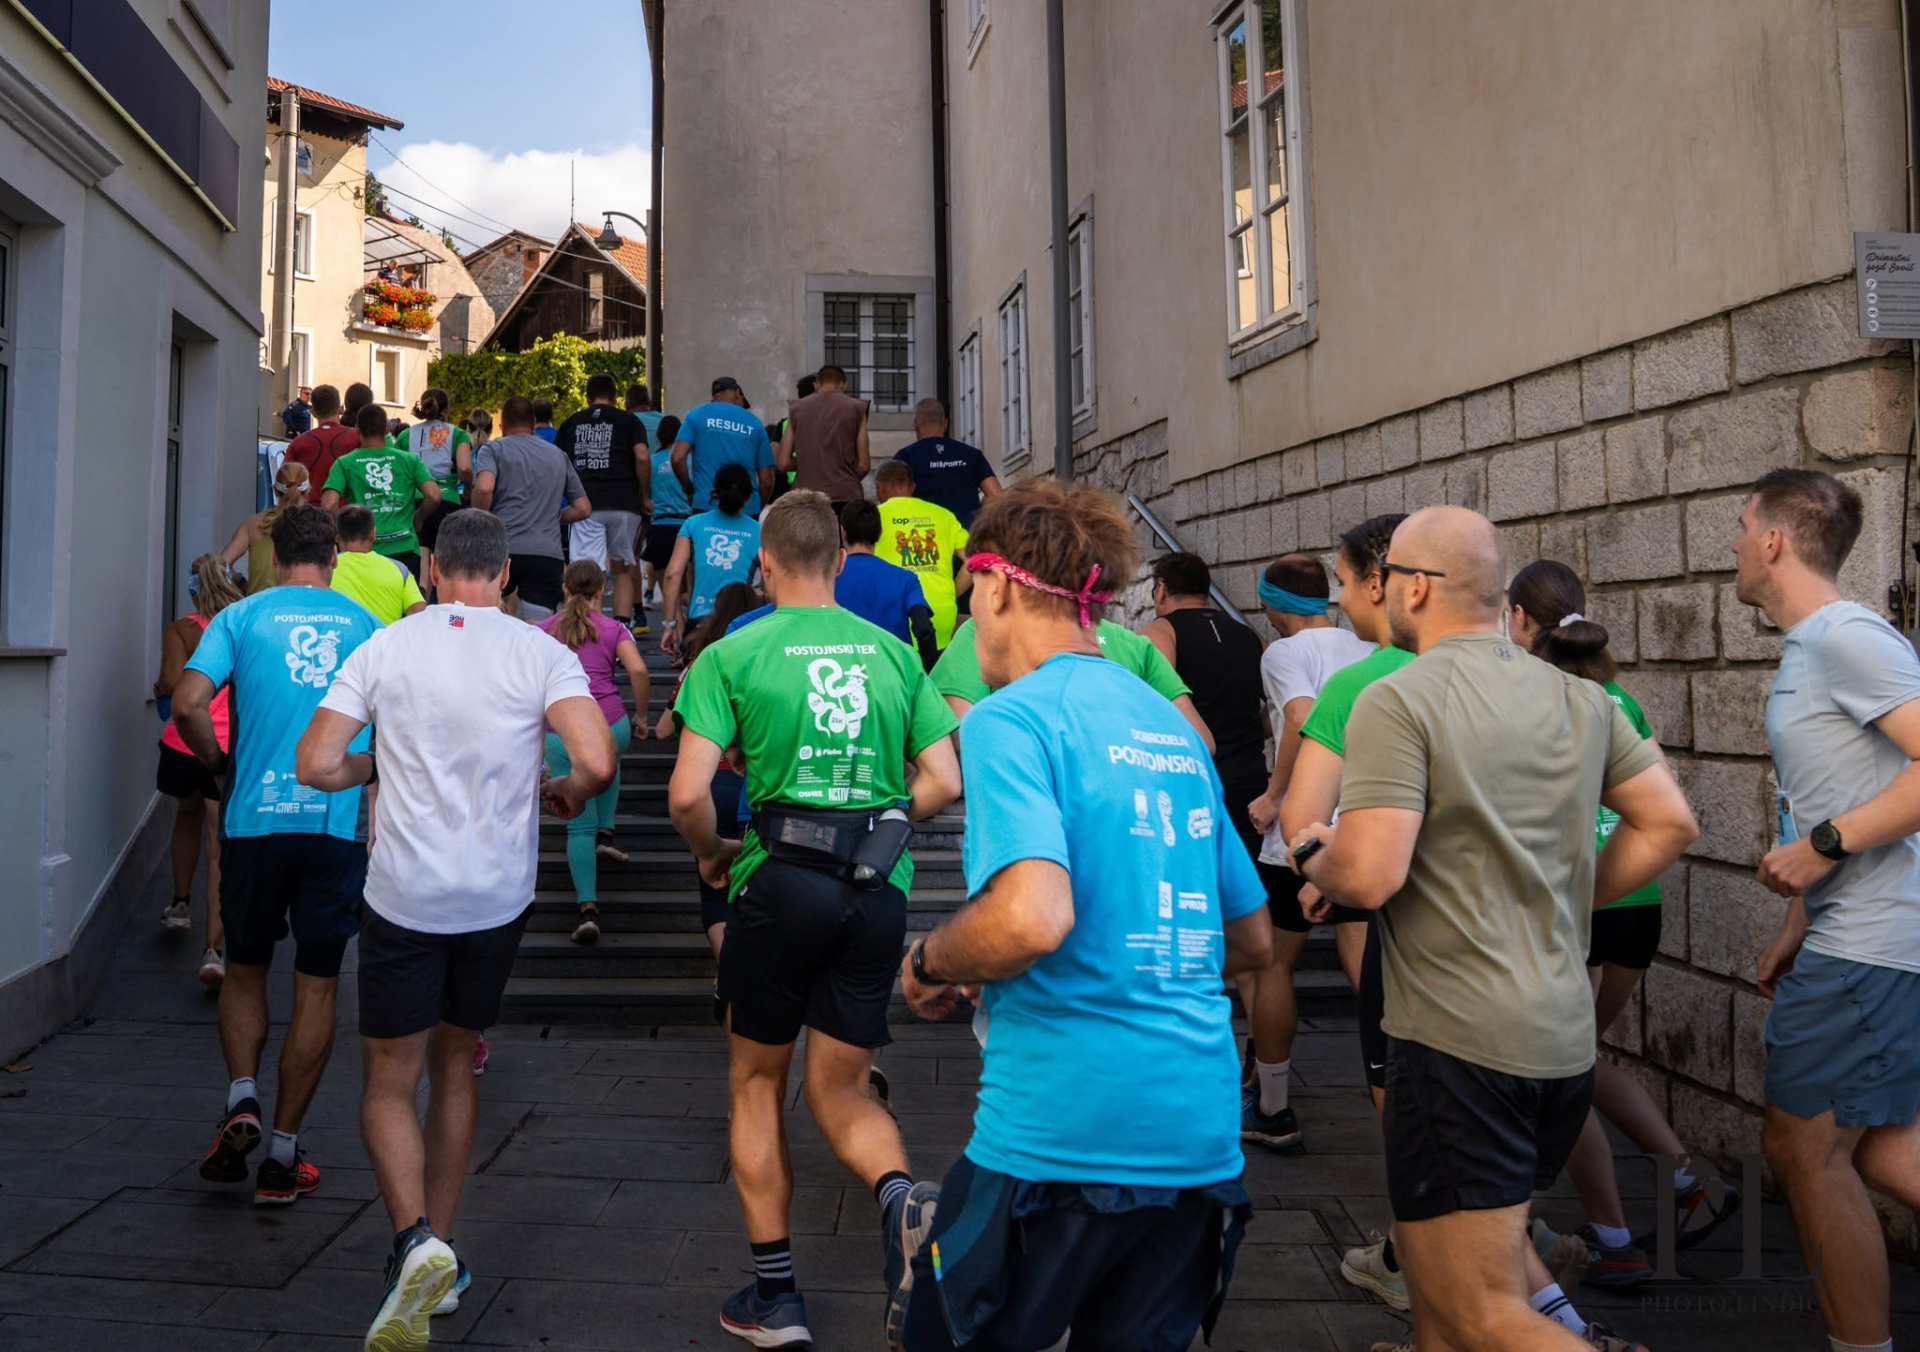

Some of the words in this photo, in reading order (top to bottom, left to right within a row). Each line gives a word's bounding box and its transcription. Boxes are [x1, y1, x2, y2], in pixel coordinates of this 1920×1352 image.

[707, 418, 754, 436] RESULT
[575, 430, 613, 442] TURNIR
[587, 458, 610, 469] 2013
[274, 614, 333, 623] POSTOJNSKI
[333, 615, 352, 626] TEK
[784, 644, 854, 656] POSTOJNSKI
[854, 644, 877, 655] TEK
[828, 787, 850, 802] ACTIV
